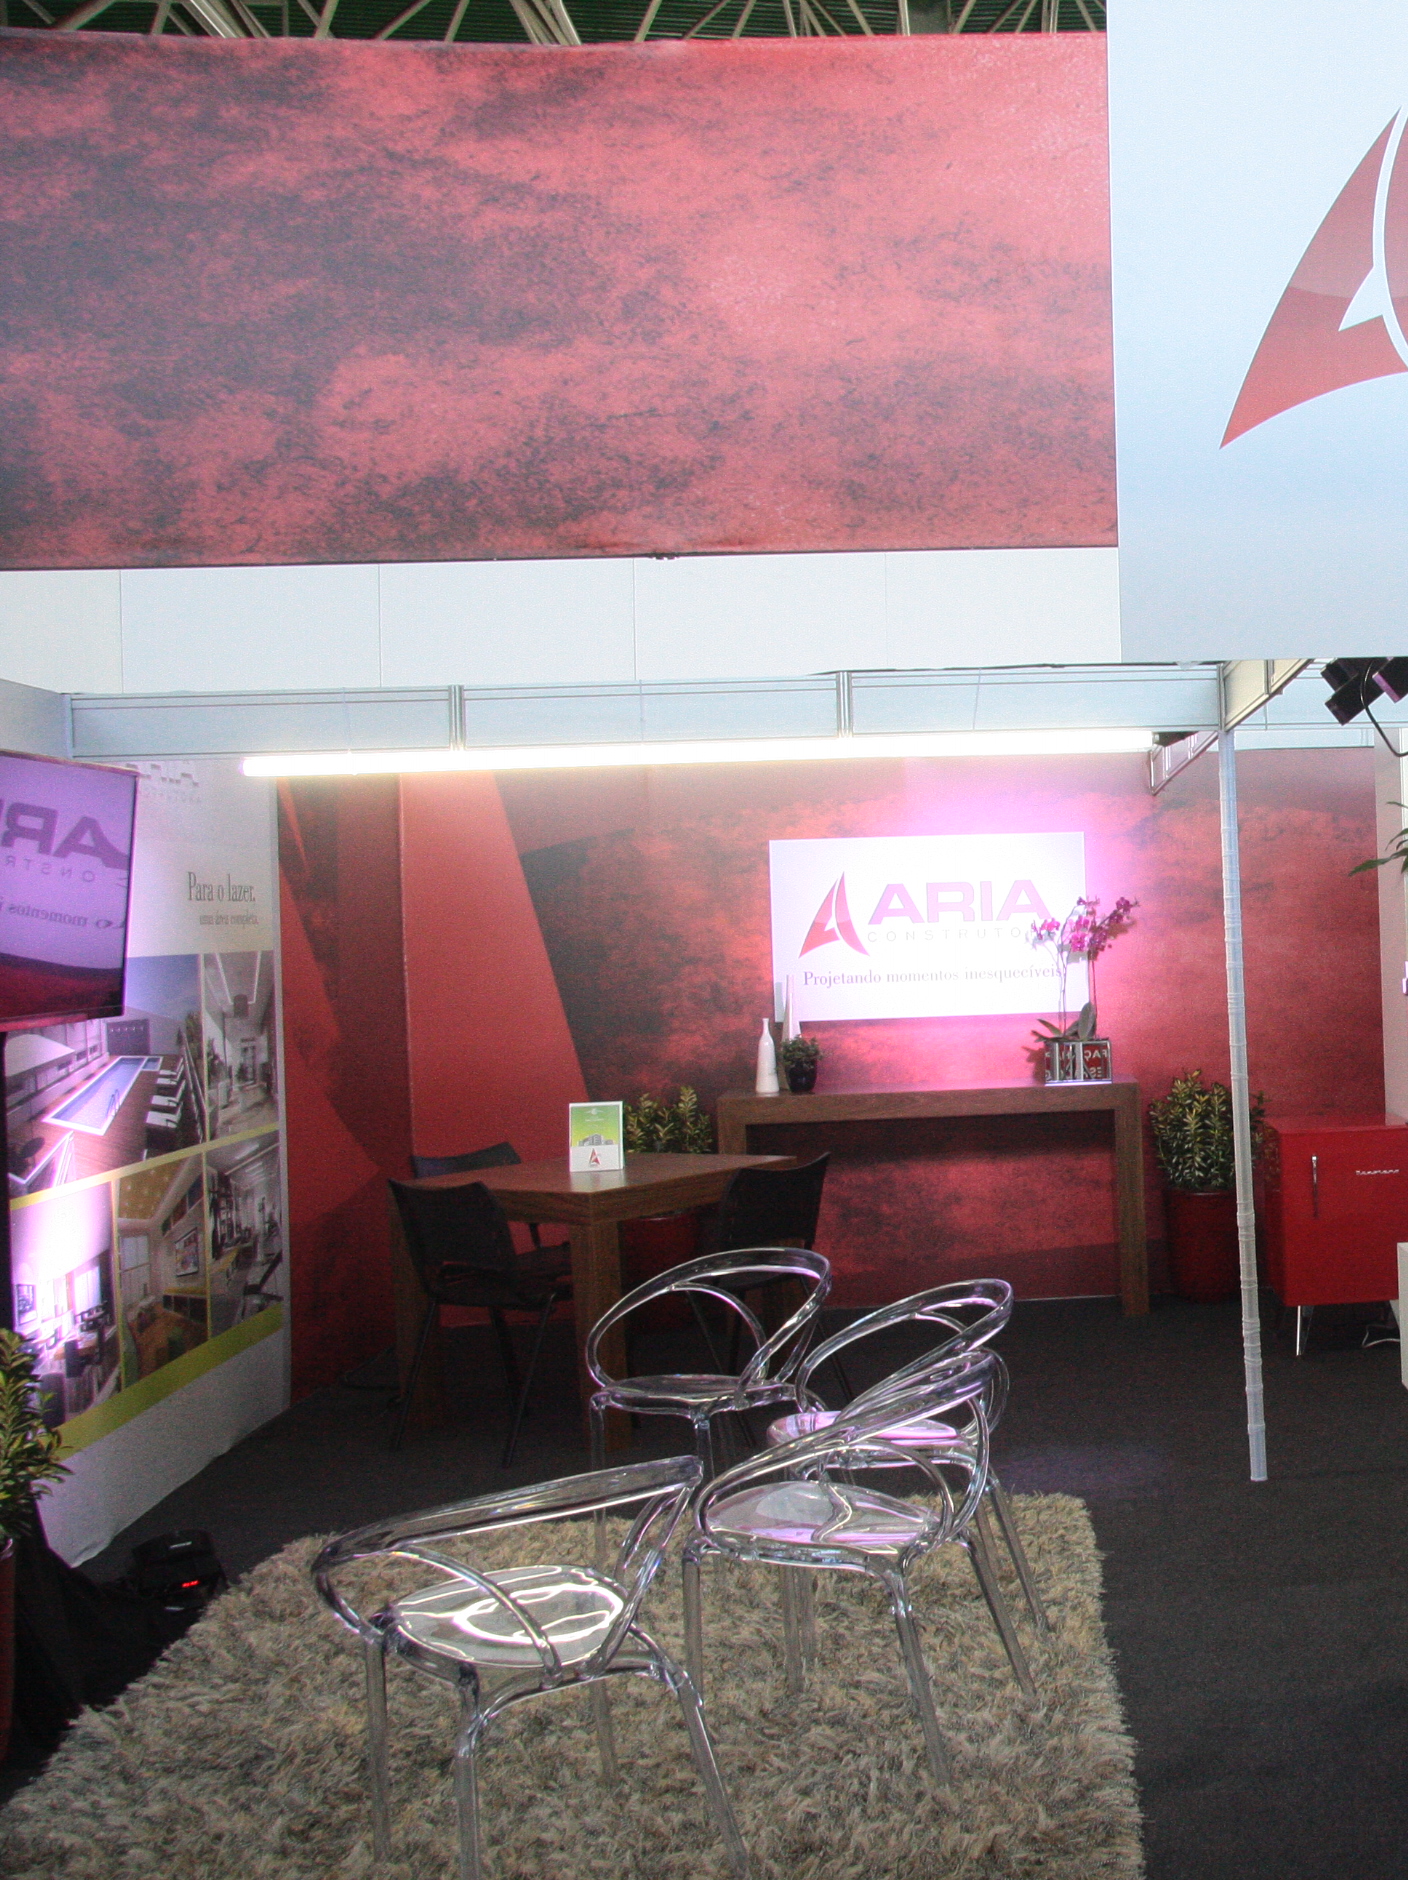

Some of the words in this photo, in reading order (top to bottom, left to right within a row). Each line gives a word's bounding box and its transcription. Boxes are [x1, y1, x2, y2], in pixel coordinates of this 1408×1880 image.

[187, 870, 214, 902] Para
[217, 884, 225, 902] o
[227, 872, 256, 902] lazer.
[868, 879, 1052, 925] ARIA
[867, 927, 1034, 943] CONSTRUTO
[803, 969, 881, 989] Projetando
[886, 969, 959, 983] momentos
[964, 964, 1062, 983] inesquecíveis
